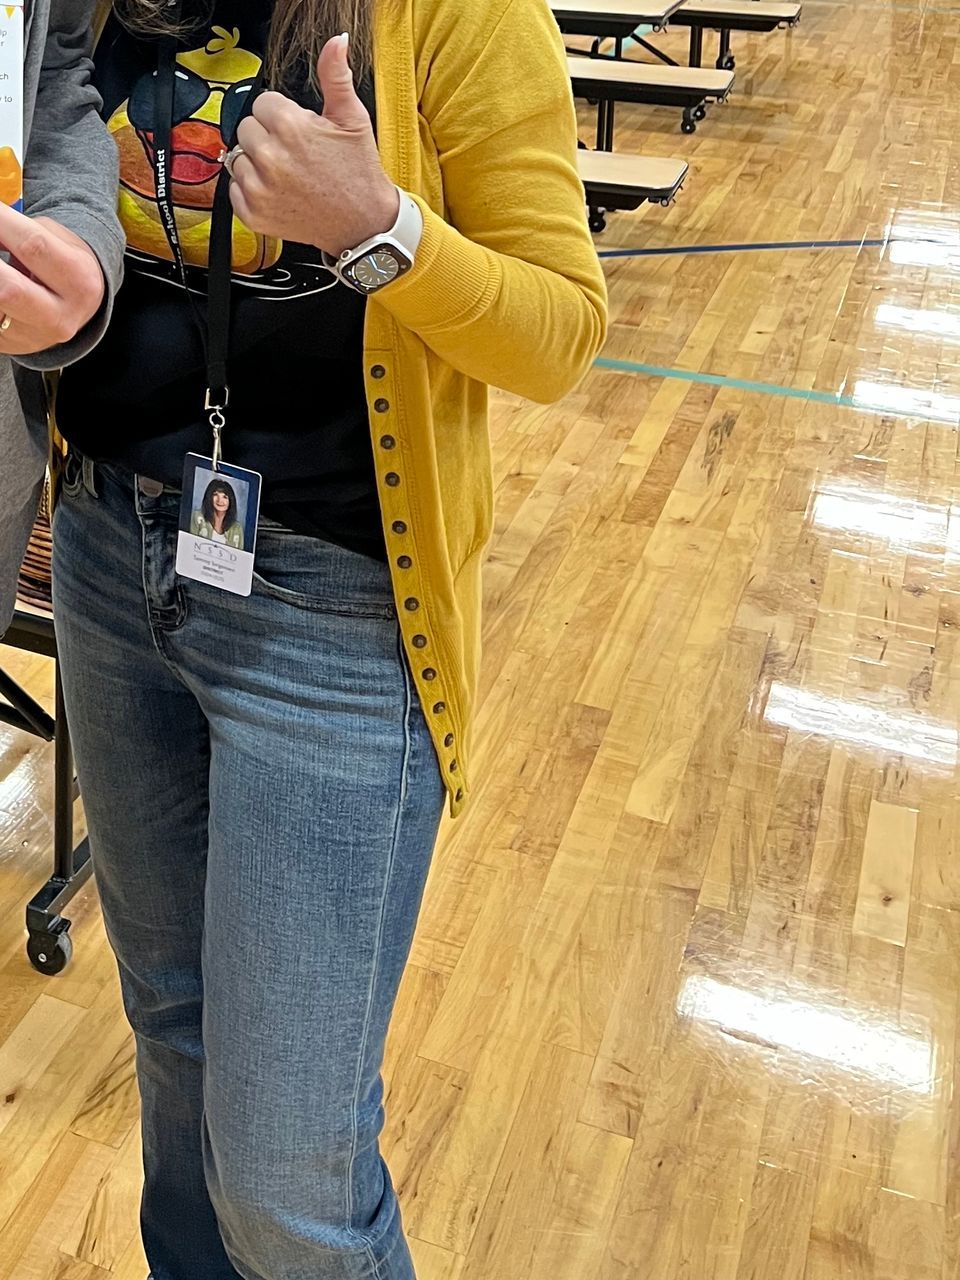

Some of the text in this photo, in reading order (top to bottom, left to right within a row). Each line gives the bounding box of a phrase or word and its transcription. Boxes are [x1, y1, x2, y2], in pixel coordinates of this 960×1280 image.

[4, 95, 13, 103] to
[156, 148, 178, 245] School District
